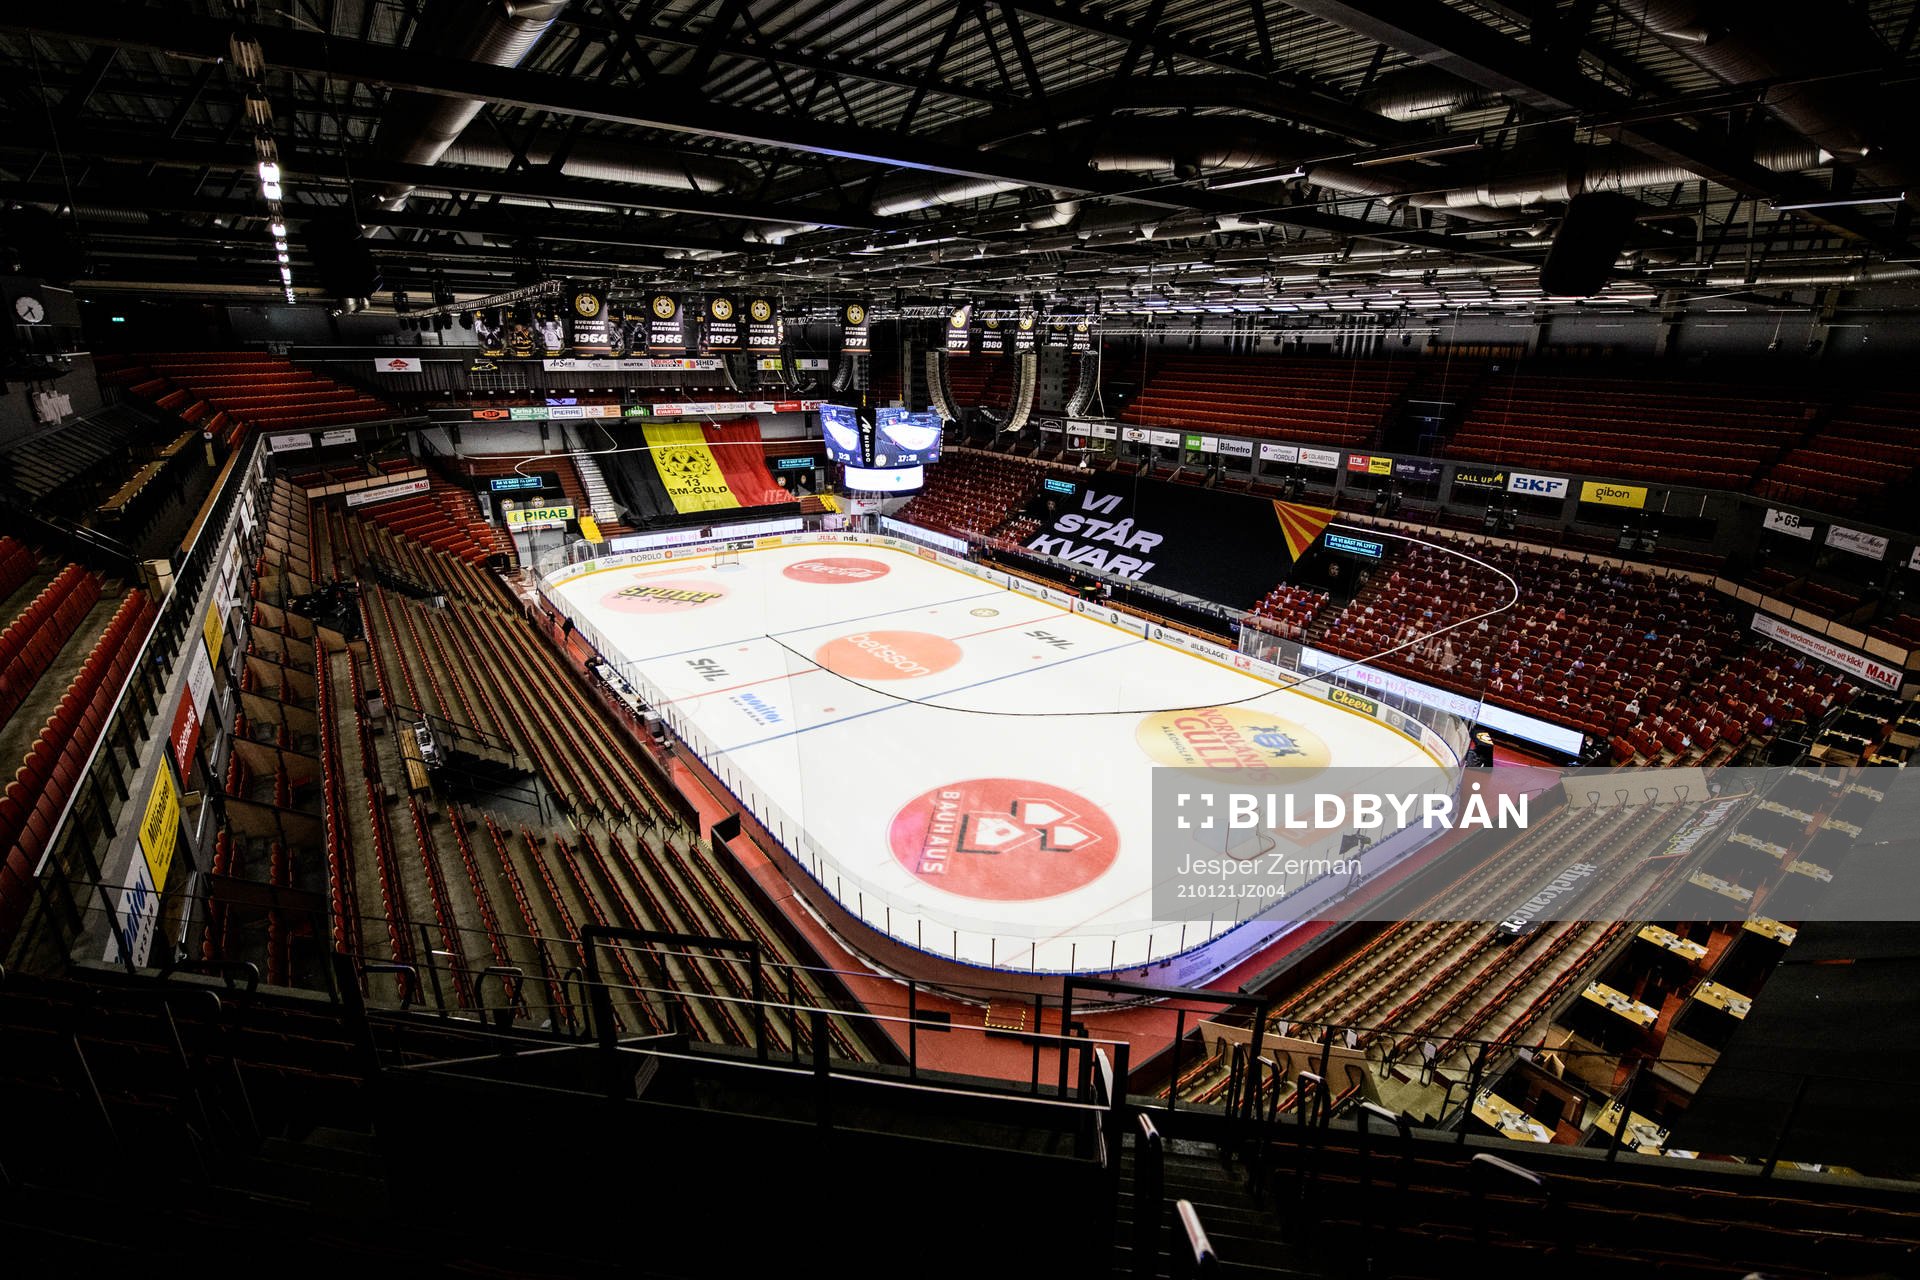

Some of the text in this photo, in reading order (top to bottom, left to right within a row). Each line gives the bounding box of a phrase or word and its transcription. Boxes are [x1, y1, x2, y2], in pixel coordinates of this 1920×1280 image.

[573, 333, 609, 344] 1964
[650, 334, 683, 344] 1966
[709, 335, 739, 345] 1967
[748, 335, 777, 346] 1968
[844, 337, 868, 347] 1971
[947, 340, 969, 348] 1977
[982, 341, 1003, 349] 1980
[1220, 442, 1251, 455] Bilmetro
[684, 478, 701, 488] 13
[1456, 473, 1493, 484] CALL UP
[1512, 477, 1563, 493] SKF
[668, 485, 728, 496] SM-GULD
[1595, 487, 1630, 501] gibon
[1080, 489, 1124, 515] VI
[523, 508, 568, 521] PIRAB
[1053, 513, 1164, 554] STÅR
[1026, 533, 1156, 581] KVAR!
[792, 561, 882, 579] Coca-Cola
[1023, 630, 1075, 650] SHL
[1775, 625, 1790, 637] Hela
[1790, 630, 1814, 647] veckans
[1845, 653, 1865, 668] klick!
[846, 632, 932, 679] betsson
[685, 658, 730, 682] SHL
[1356, 669, 1382, 684] MED
[1332, 688, 1374, 714] Cheers
[1173, 716, 1243, 773] GULD
[1198, 708, 1281, 782] NORRLANDS
[923, 791, 960, 874] BAUHAUS
